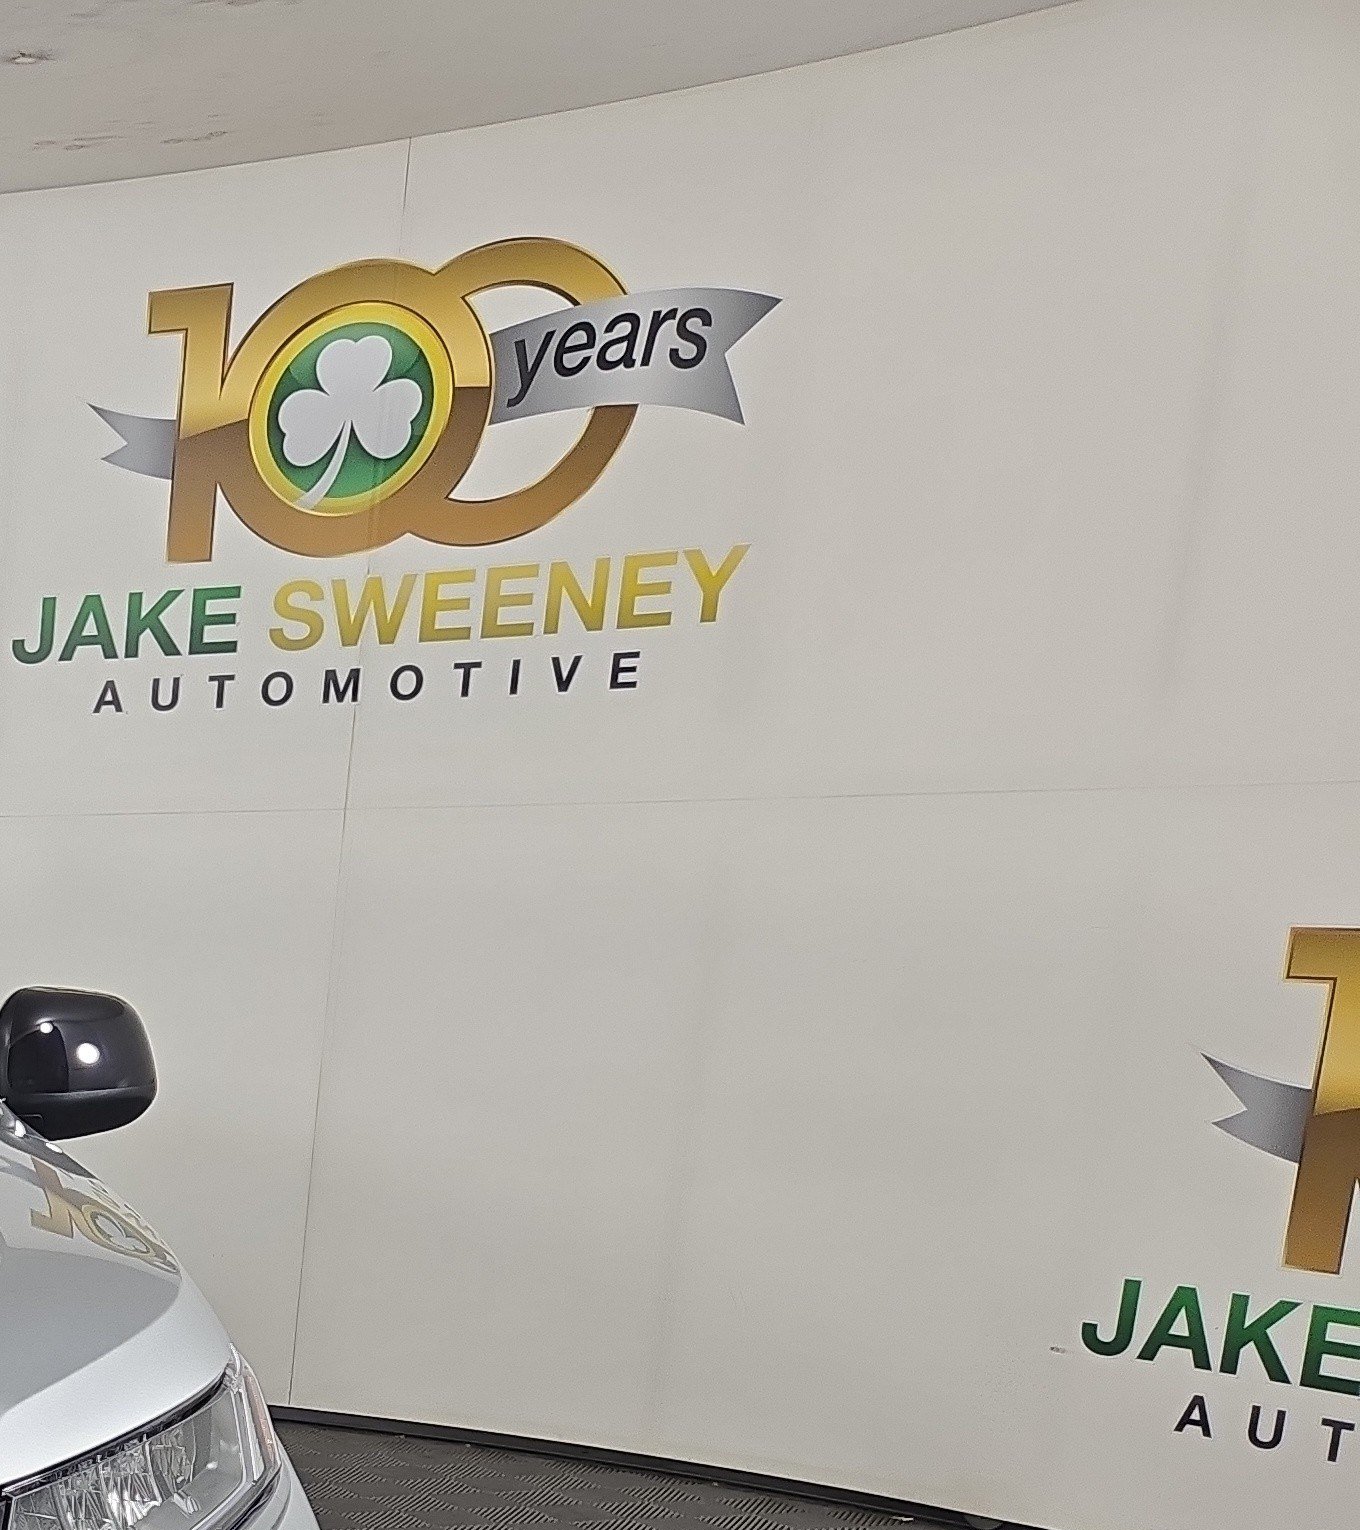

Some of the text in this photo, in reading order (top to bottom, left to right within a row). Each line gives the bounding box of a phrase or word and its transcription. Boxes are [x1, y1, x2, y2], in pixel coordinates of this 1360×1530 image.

[147, 236, 638, 564] 100
[505, 306, 713, 408] years
[12, 545, 751, 665] JAKE SWEENEY
[93, 651, 643, 714] AUTOMOTIVE
[1082, 1278, 1360, 1396] JAKE
